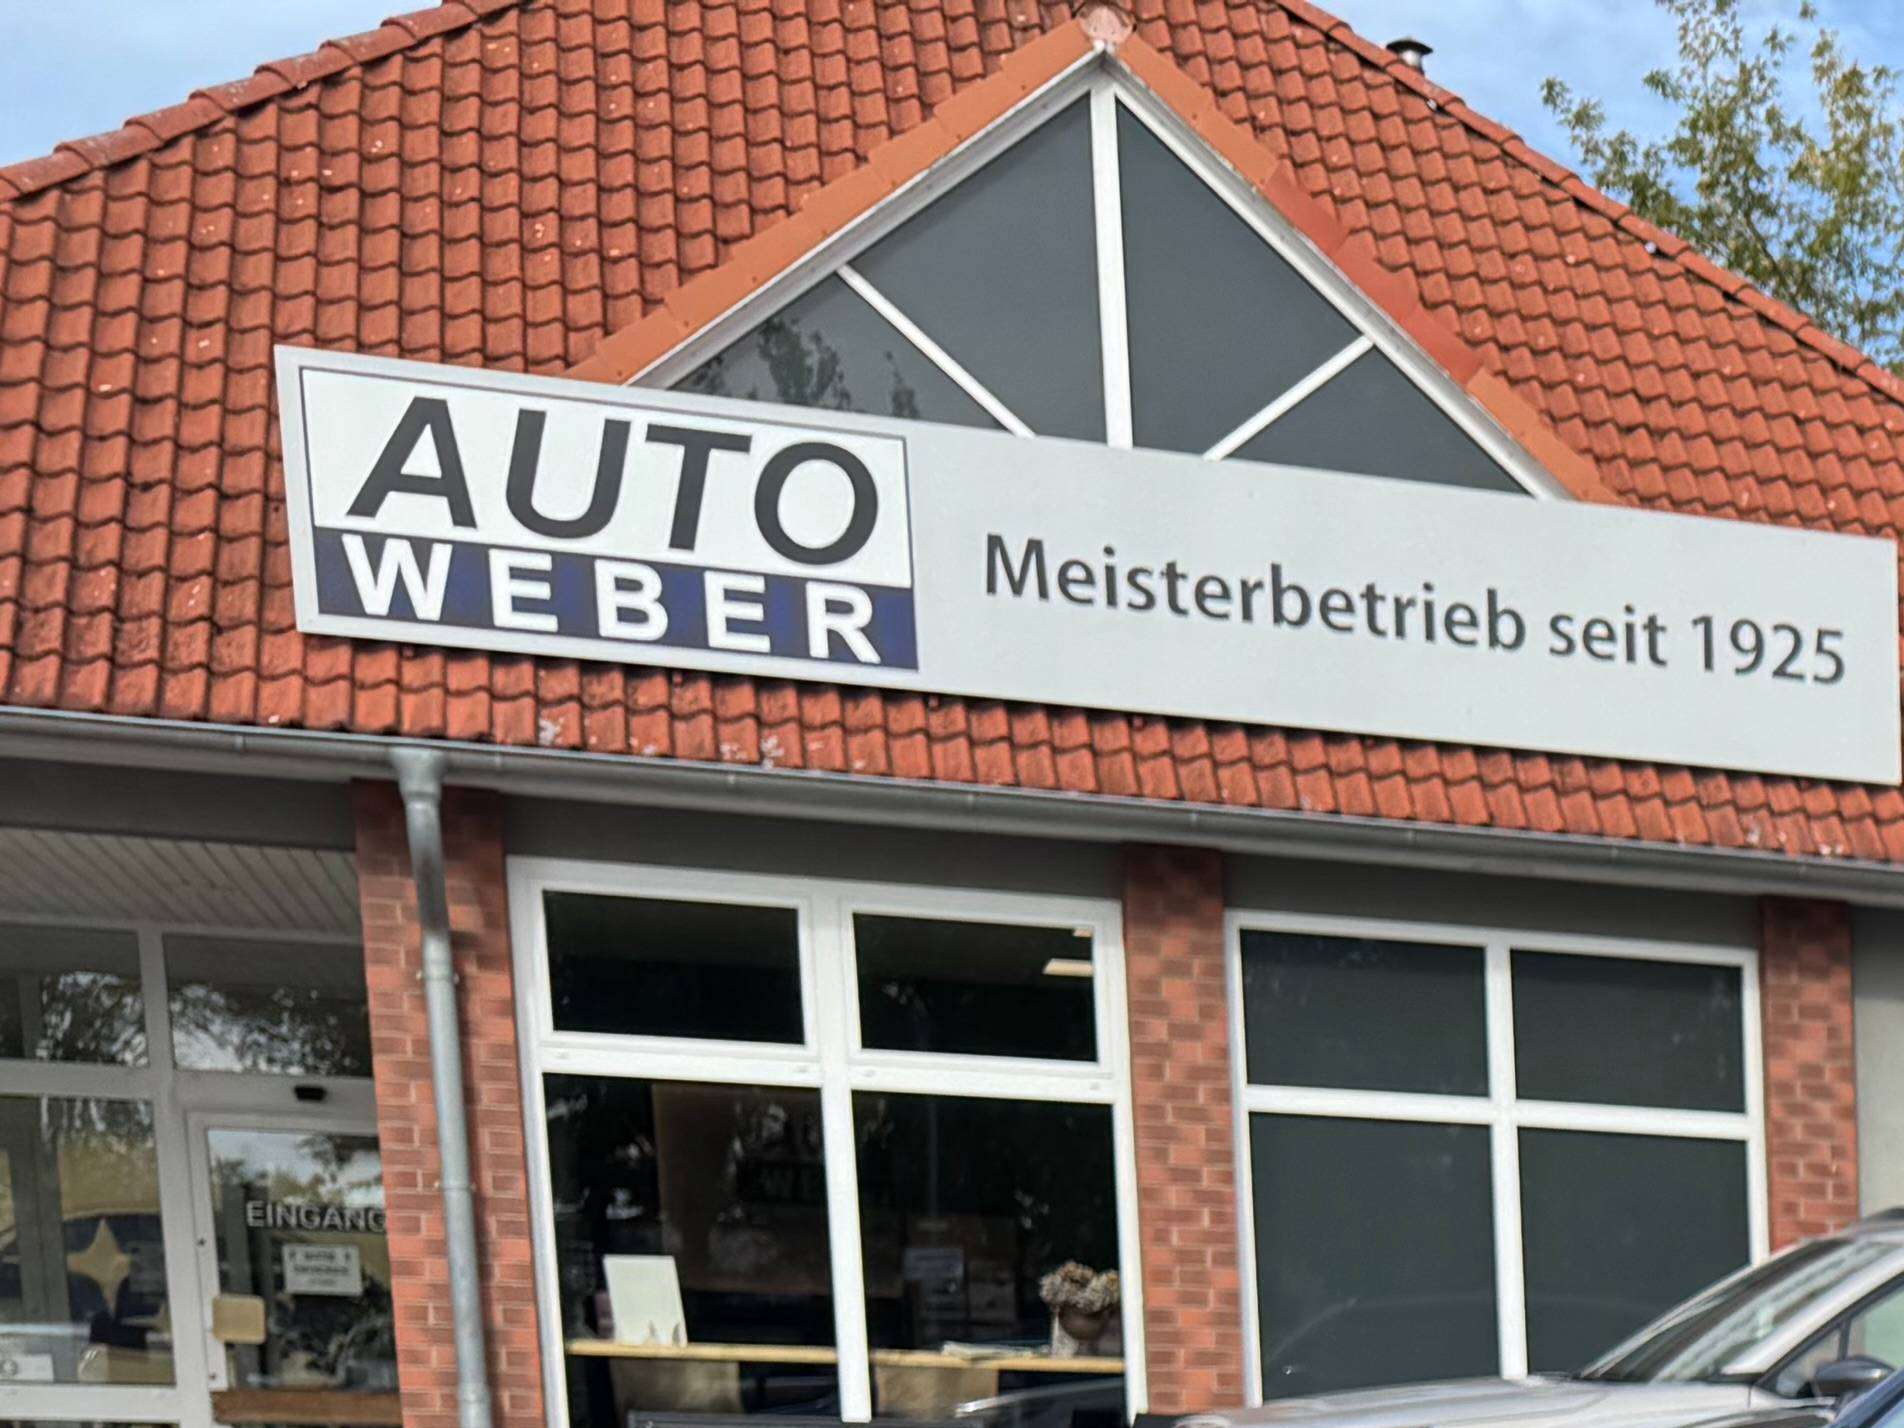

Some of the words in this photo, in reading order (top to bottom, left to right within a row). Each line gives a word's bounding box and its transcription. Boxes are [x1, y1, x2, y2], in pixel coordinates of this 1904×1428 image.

[346, 397, 879, 566] AUTO
[342, 534, 882, 664] WEBER
[984, 533, 1526, 654] Meisterbetrieb
[1549, 602, 1668, 668] seit
[1689, 613, 1848, 686] 1925
[246, 1200, 386, 1233] EINGANG
